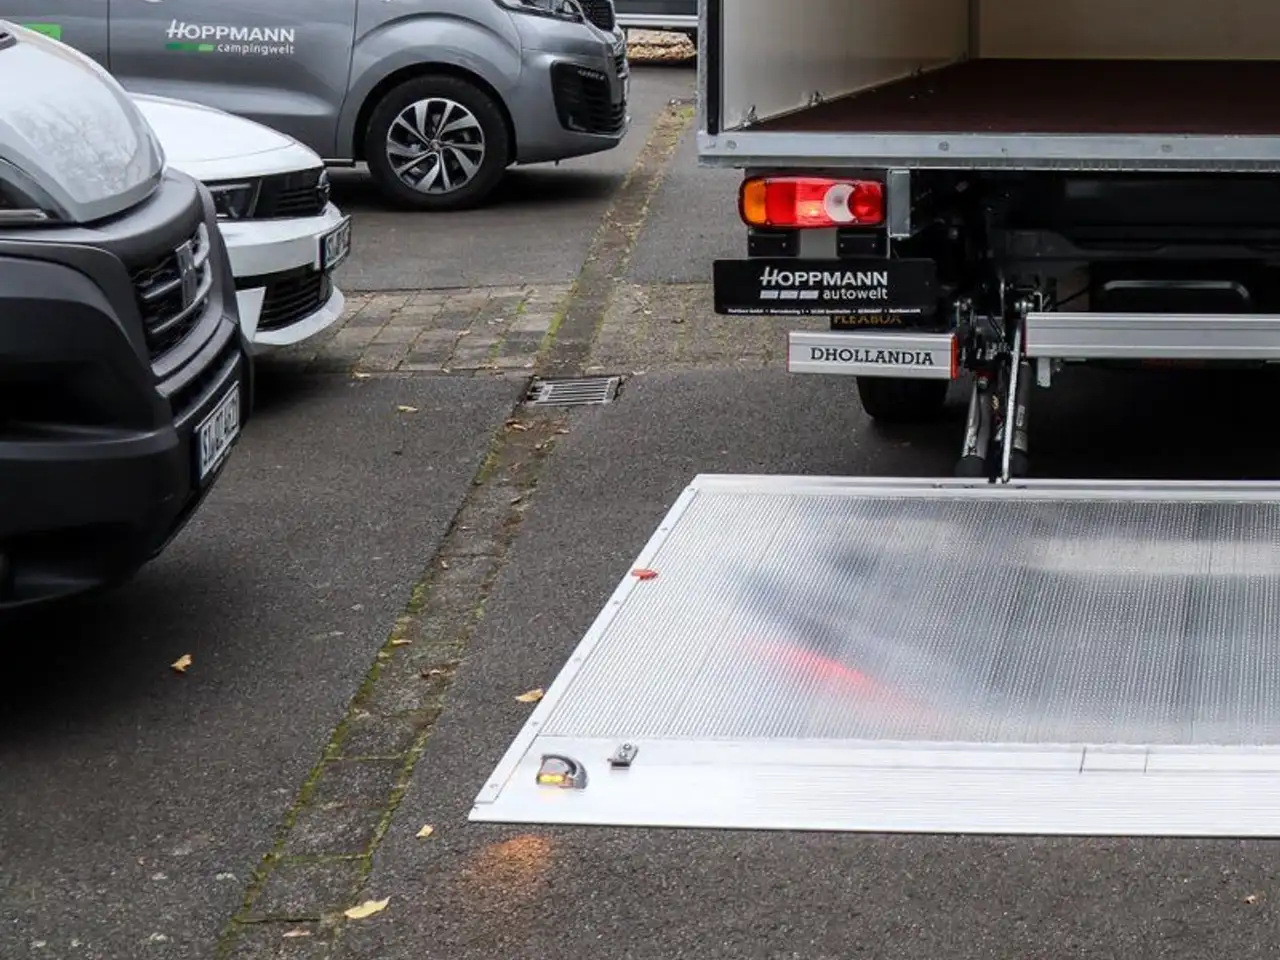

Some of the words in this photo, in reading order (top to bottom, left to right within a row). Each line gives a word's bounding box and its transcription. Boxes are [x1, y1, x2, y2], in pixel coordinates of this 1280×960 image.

[166, 19, 295, 42] HOPPMANN
[217, 42, 295, 56] campingwelt
[760, 266, 888, 287] HOPPMANN
[823, 288, 888, 300] autowelt
[810, 347, 934, 366] DHOLLANDIA
